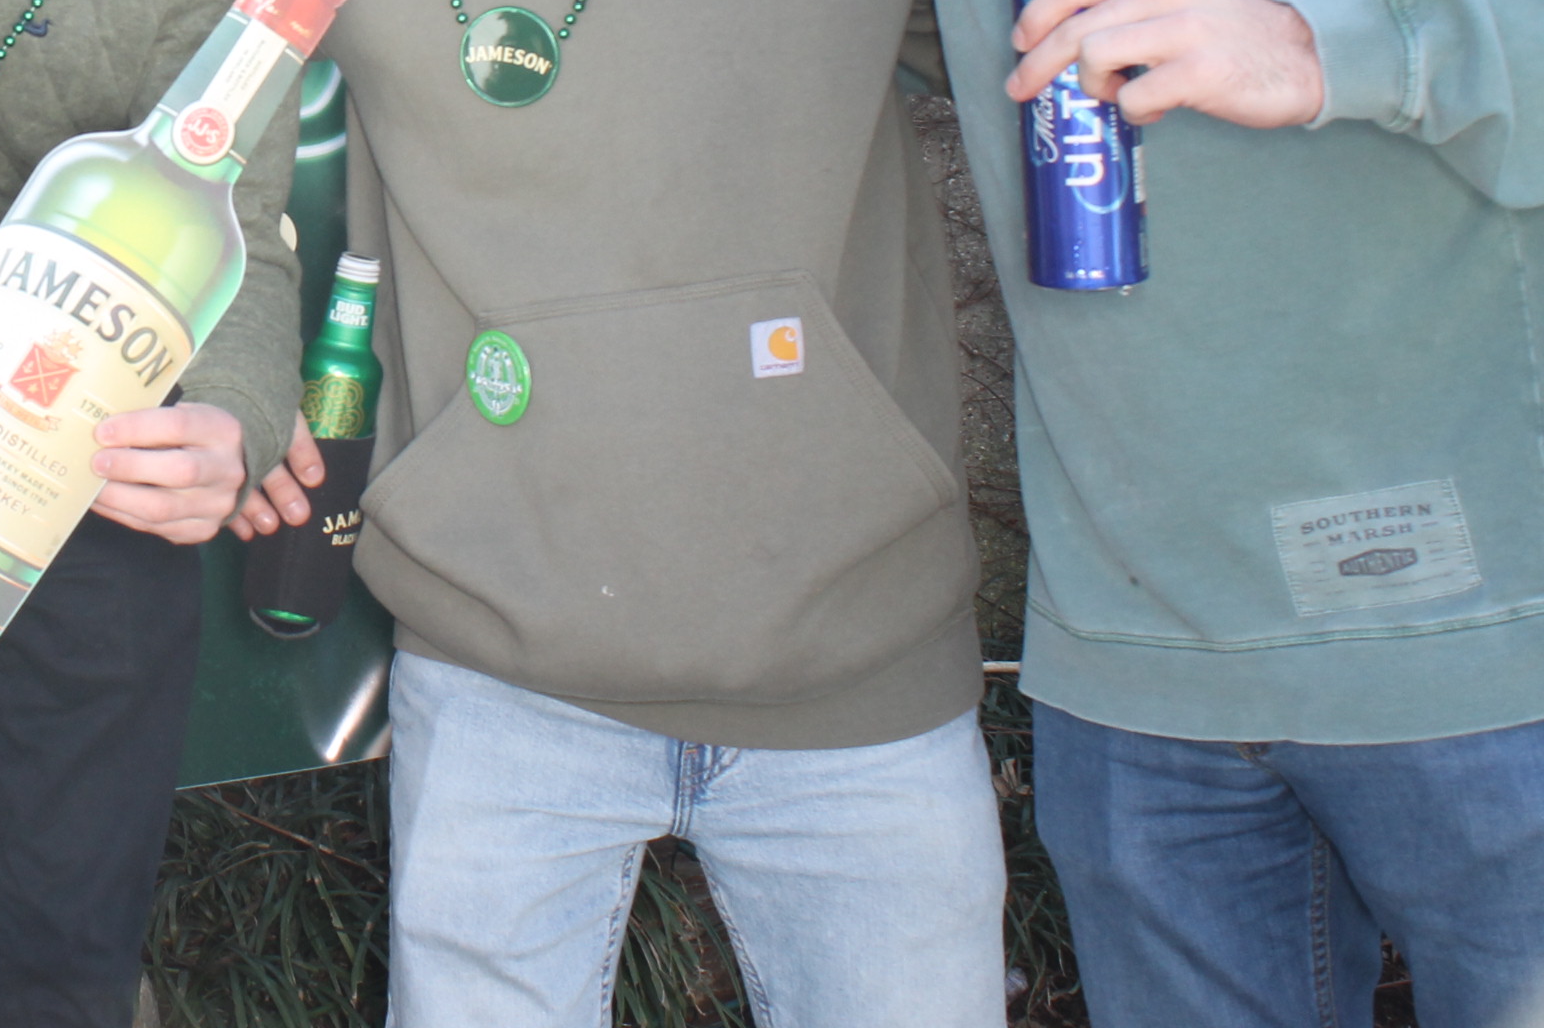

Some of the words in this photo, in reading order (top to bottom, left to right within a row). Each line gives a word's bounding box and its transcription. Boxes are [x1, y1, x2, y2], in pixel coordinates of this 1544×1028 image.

[465, 45, 551, 75] JAMESON
[1061, 67, 1105, 186] ULT
[329, 308, 369, 326] LIGHT
[336, 300, 365, 316] BUD
[1300, 503, 1433, 535] SOUTHERN
[1327, 523, 1414, 546] MARSH
